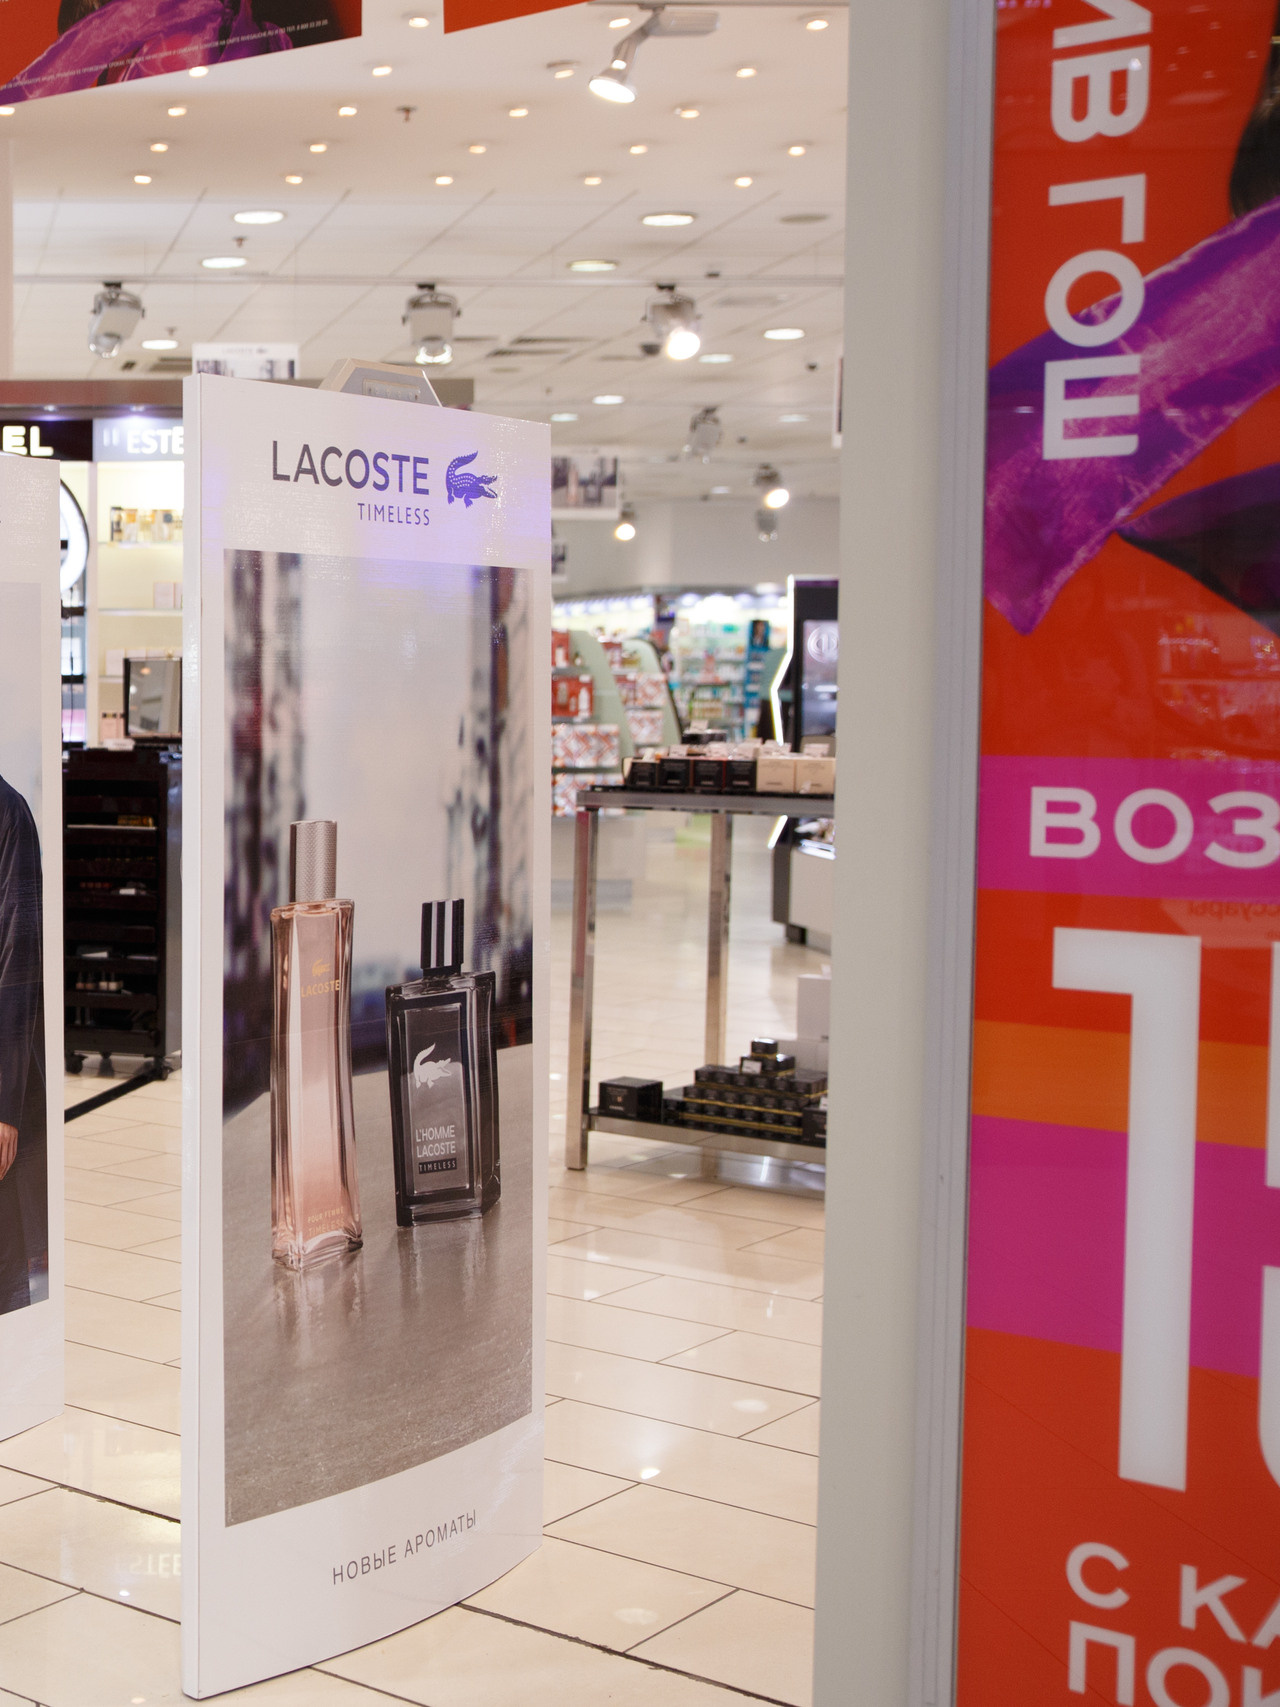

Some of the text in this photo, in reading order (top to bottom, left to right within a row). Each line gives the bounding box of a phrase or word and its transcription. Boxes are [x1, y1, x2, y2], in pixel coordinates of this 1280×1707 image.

[1042, 172, 1147, 460] ГОШ
[272, 440, 431, 496] LACOSTE
[357, 502, 431, 526] TIMELESS
[300, 979, 341, 998] LACOSTE
[415, 1124, 456, 1143] L'HOMME
[416, 1140, 456, 1158] LACOSTE
[419, 1160, 456, 1172] TIMELESS
[1052, 926, 1280, 1492] 1
[331, 1509, 477, 1586] НОВЫЕ АРОМАТЫ
[1065, 1541, 1131, 1610] С
